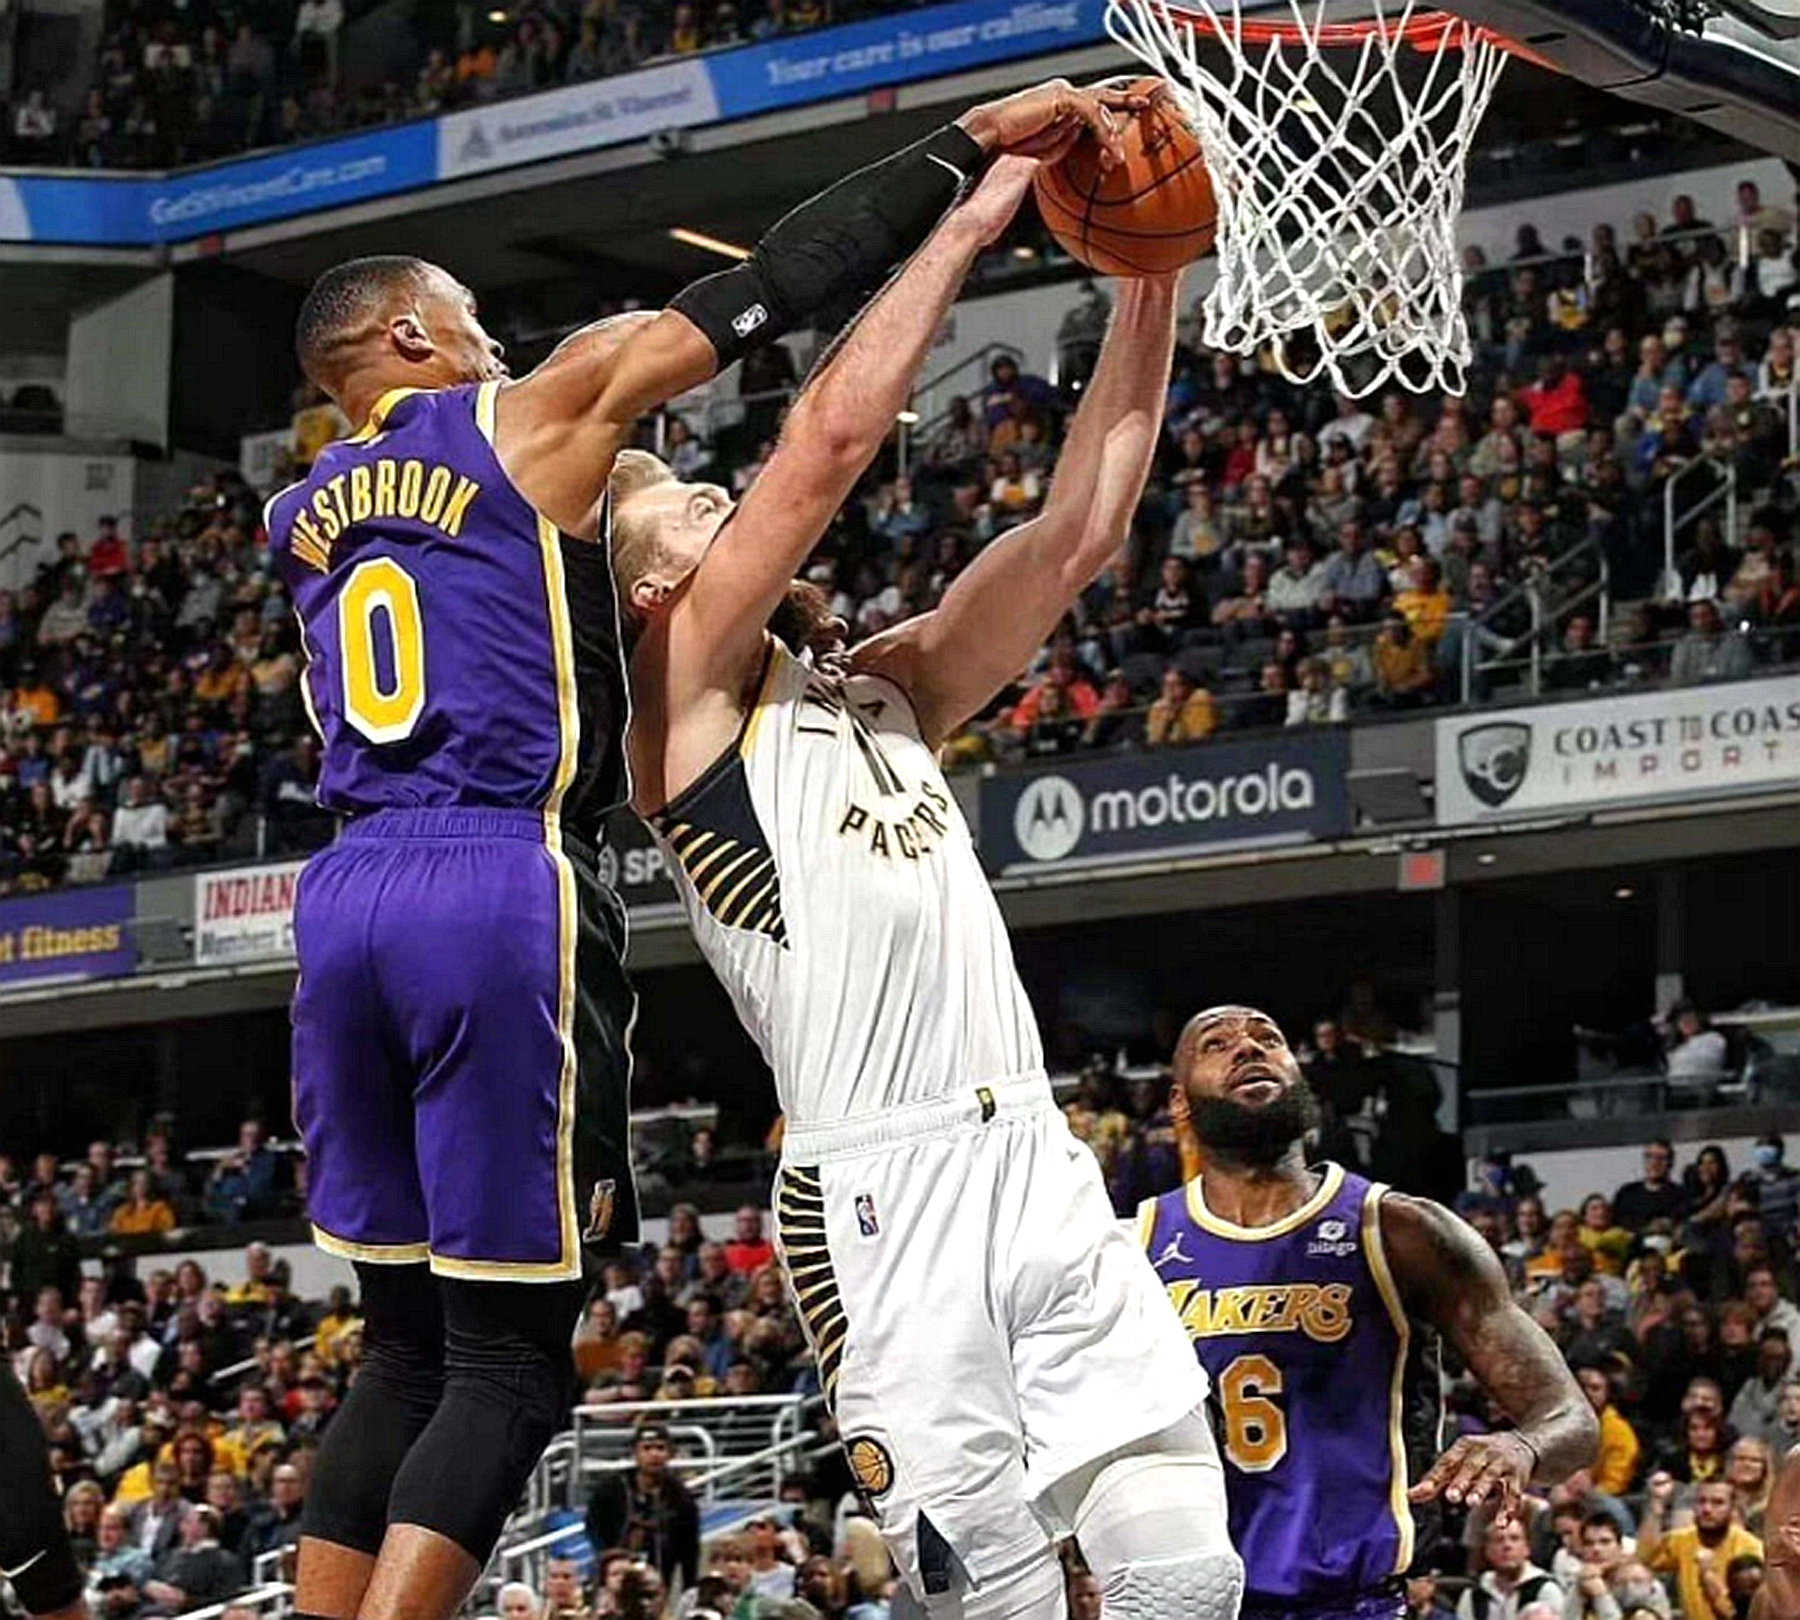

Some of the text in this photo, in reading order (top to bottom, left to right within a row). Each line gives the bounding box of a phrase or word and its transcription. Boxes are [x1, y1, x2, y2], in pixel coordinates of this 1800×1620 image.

[832, 44, 893, 71] care
[290, 458, 481, 575] WESTBROOK
[338, 556, 426, 745] 0
[1553, 717, 1670, 757] COAST
[1092, 762, 1314, 833] motorola
[624, 846, 671, 884] SP
[20, 925, 120, 960] fitness
[1219, 1353, 1288, 1473] 6
